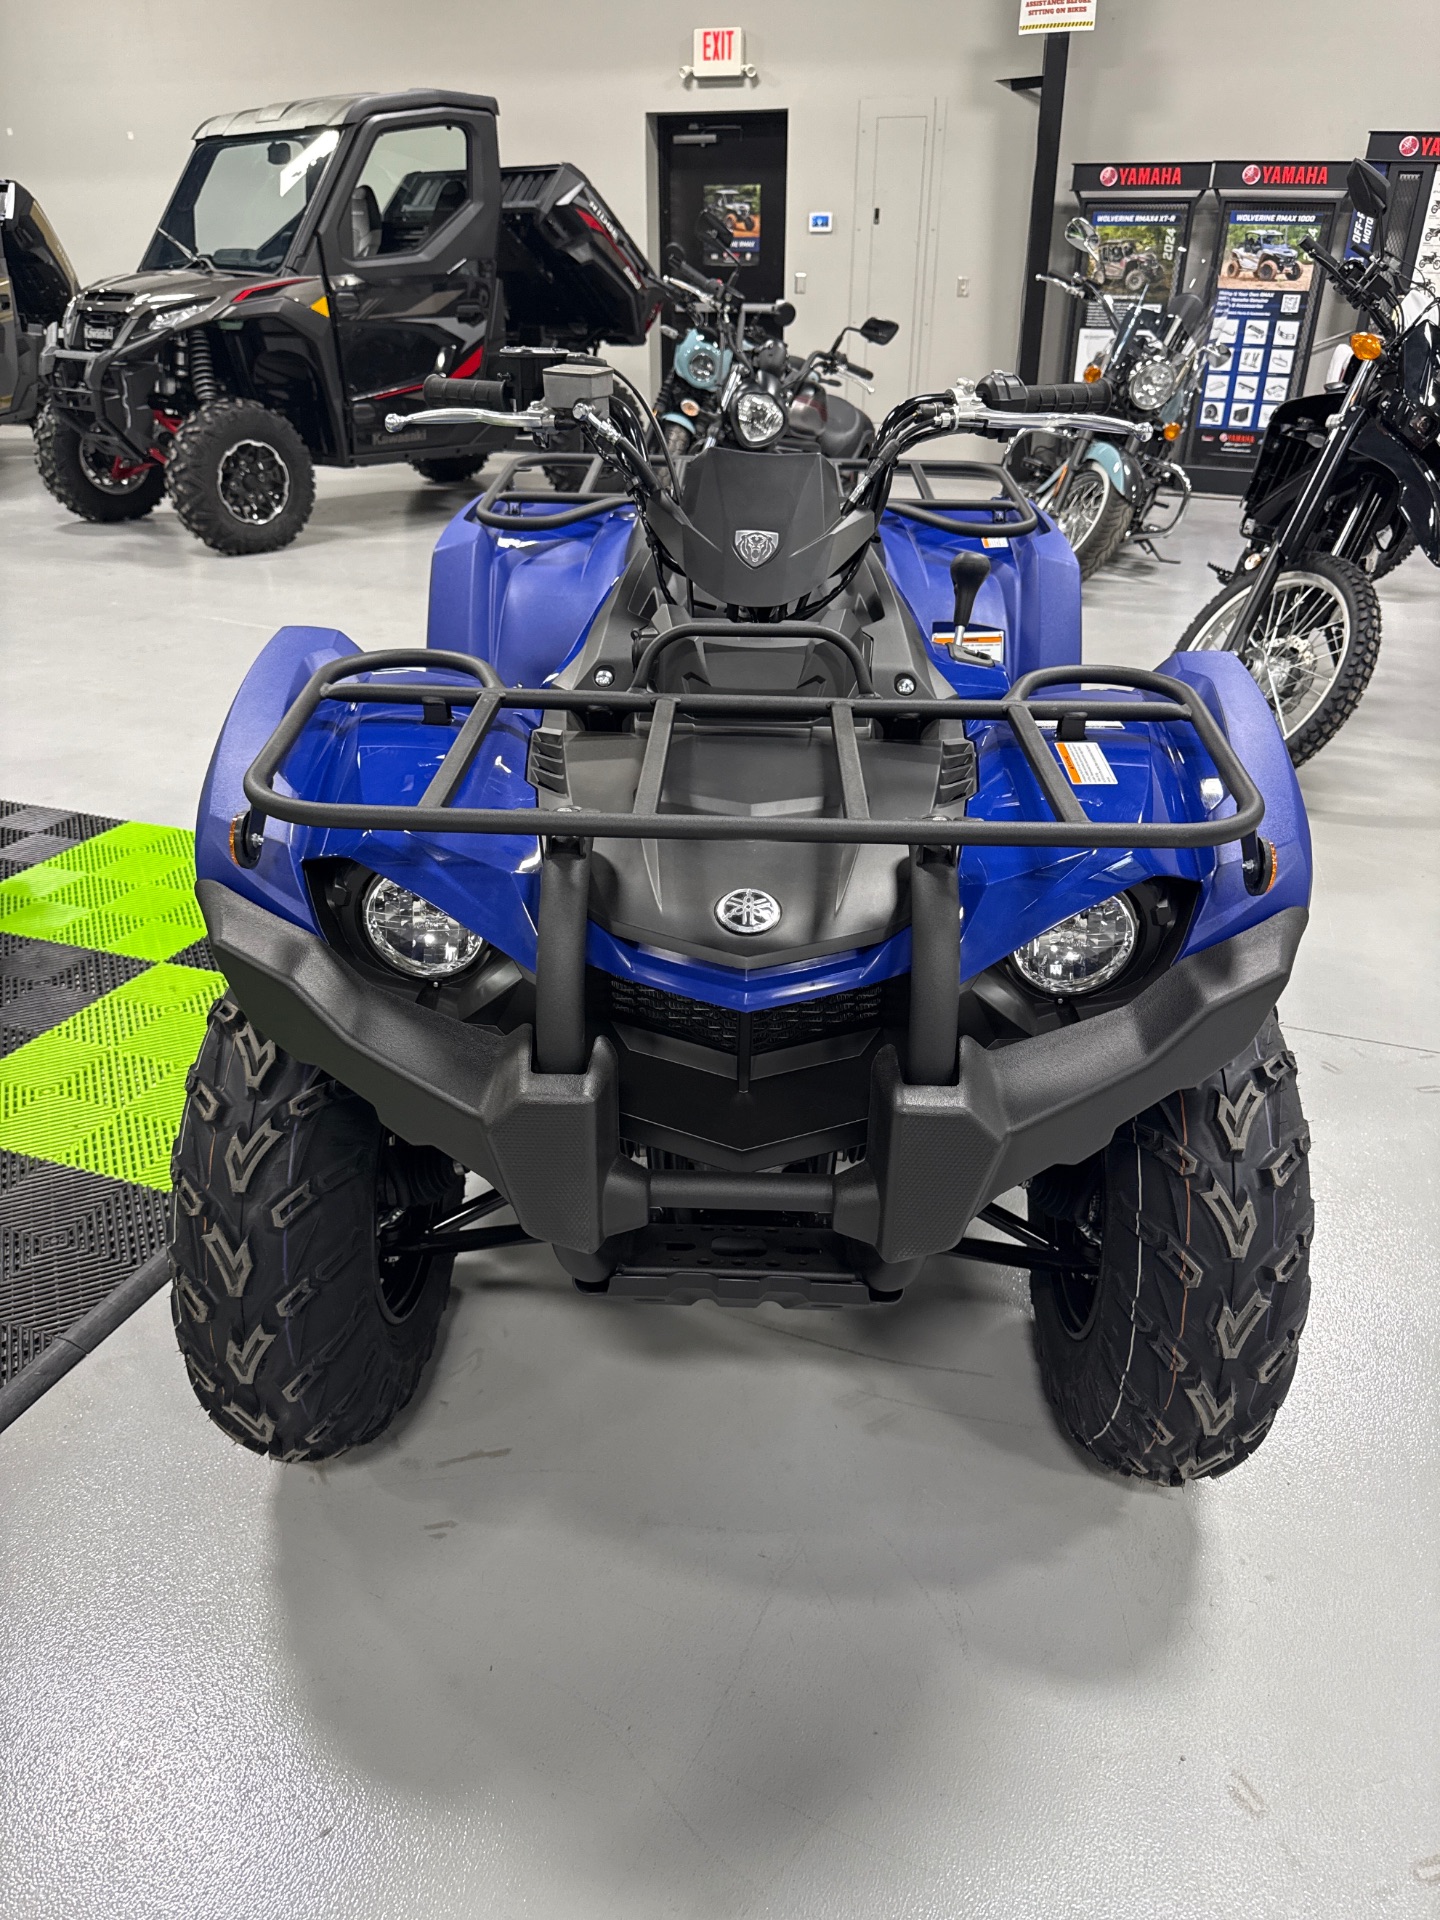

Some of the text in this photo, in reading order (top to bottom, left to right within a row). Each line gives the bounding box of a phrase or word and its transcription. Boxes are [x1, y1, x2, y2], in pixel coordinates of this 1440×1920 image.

[1028, 8, 1054, 16] SITTING
[703, 31, 734, 61] EXIT
[1421, 136, 1440, 156] YA
[1119, 167, 1182, 185] YAMAHA
[1262, 166, 1328, 185] YAMAHA
[1097, 214, 1135, 222] WOLVERINE
[1159, 214, 1177, 222] XT-R
[1236, 213, 1316, 222] WOLVERINE RMAX 1000
[1361, 216, 1374, 245] MOTO
[1162, 227, 1177, 261] 2024
